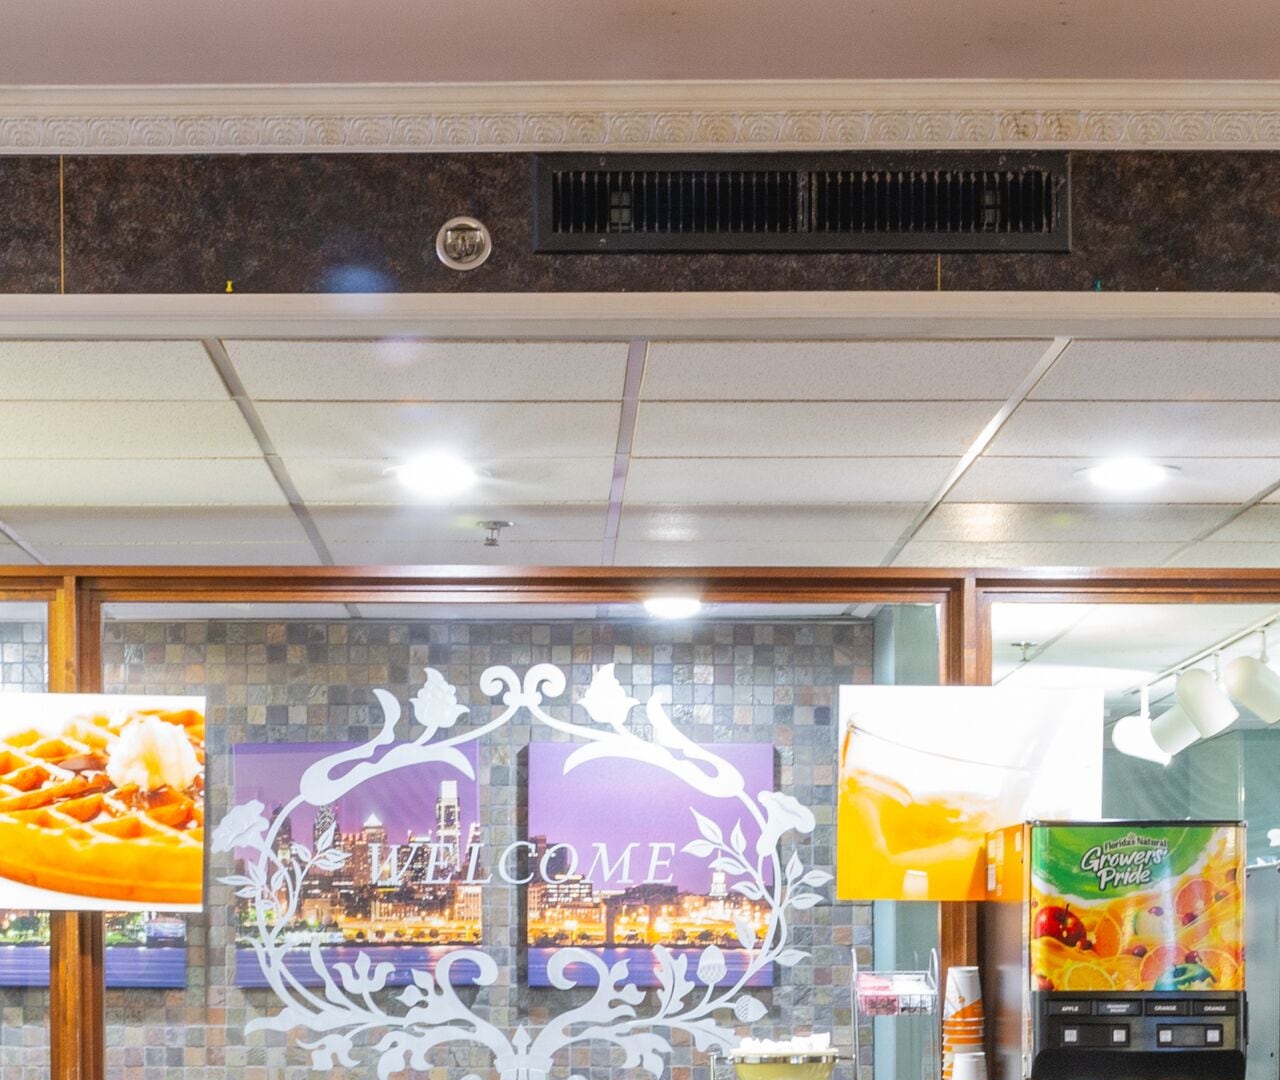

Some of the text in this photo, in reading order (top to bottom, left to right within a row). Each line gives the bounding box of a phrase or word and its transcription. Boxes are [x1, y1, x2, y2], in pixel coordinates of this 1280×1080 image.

[1137, 836, 1168, 848] Natural
[367, 840, 676, 885] WELCOME
[1097, 864, 1152, 890] Pride
